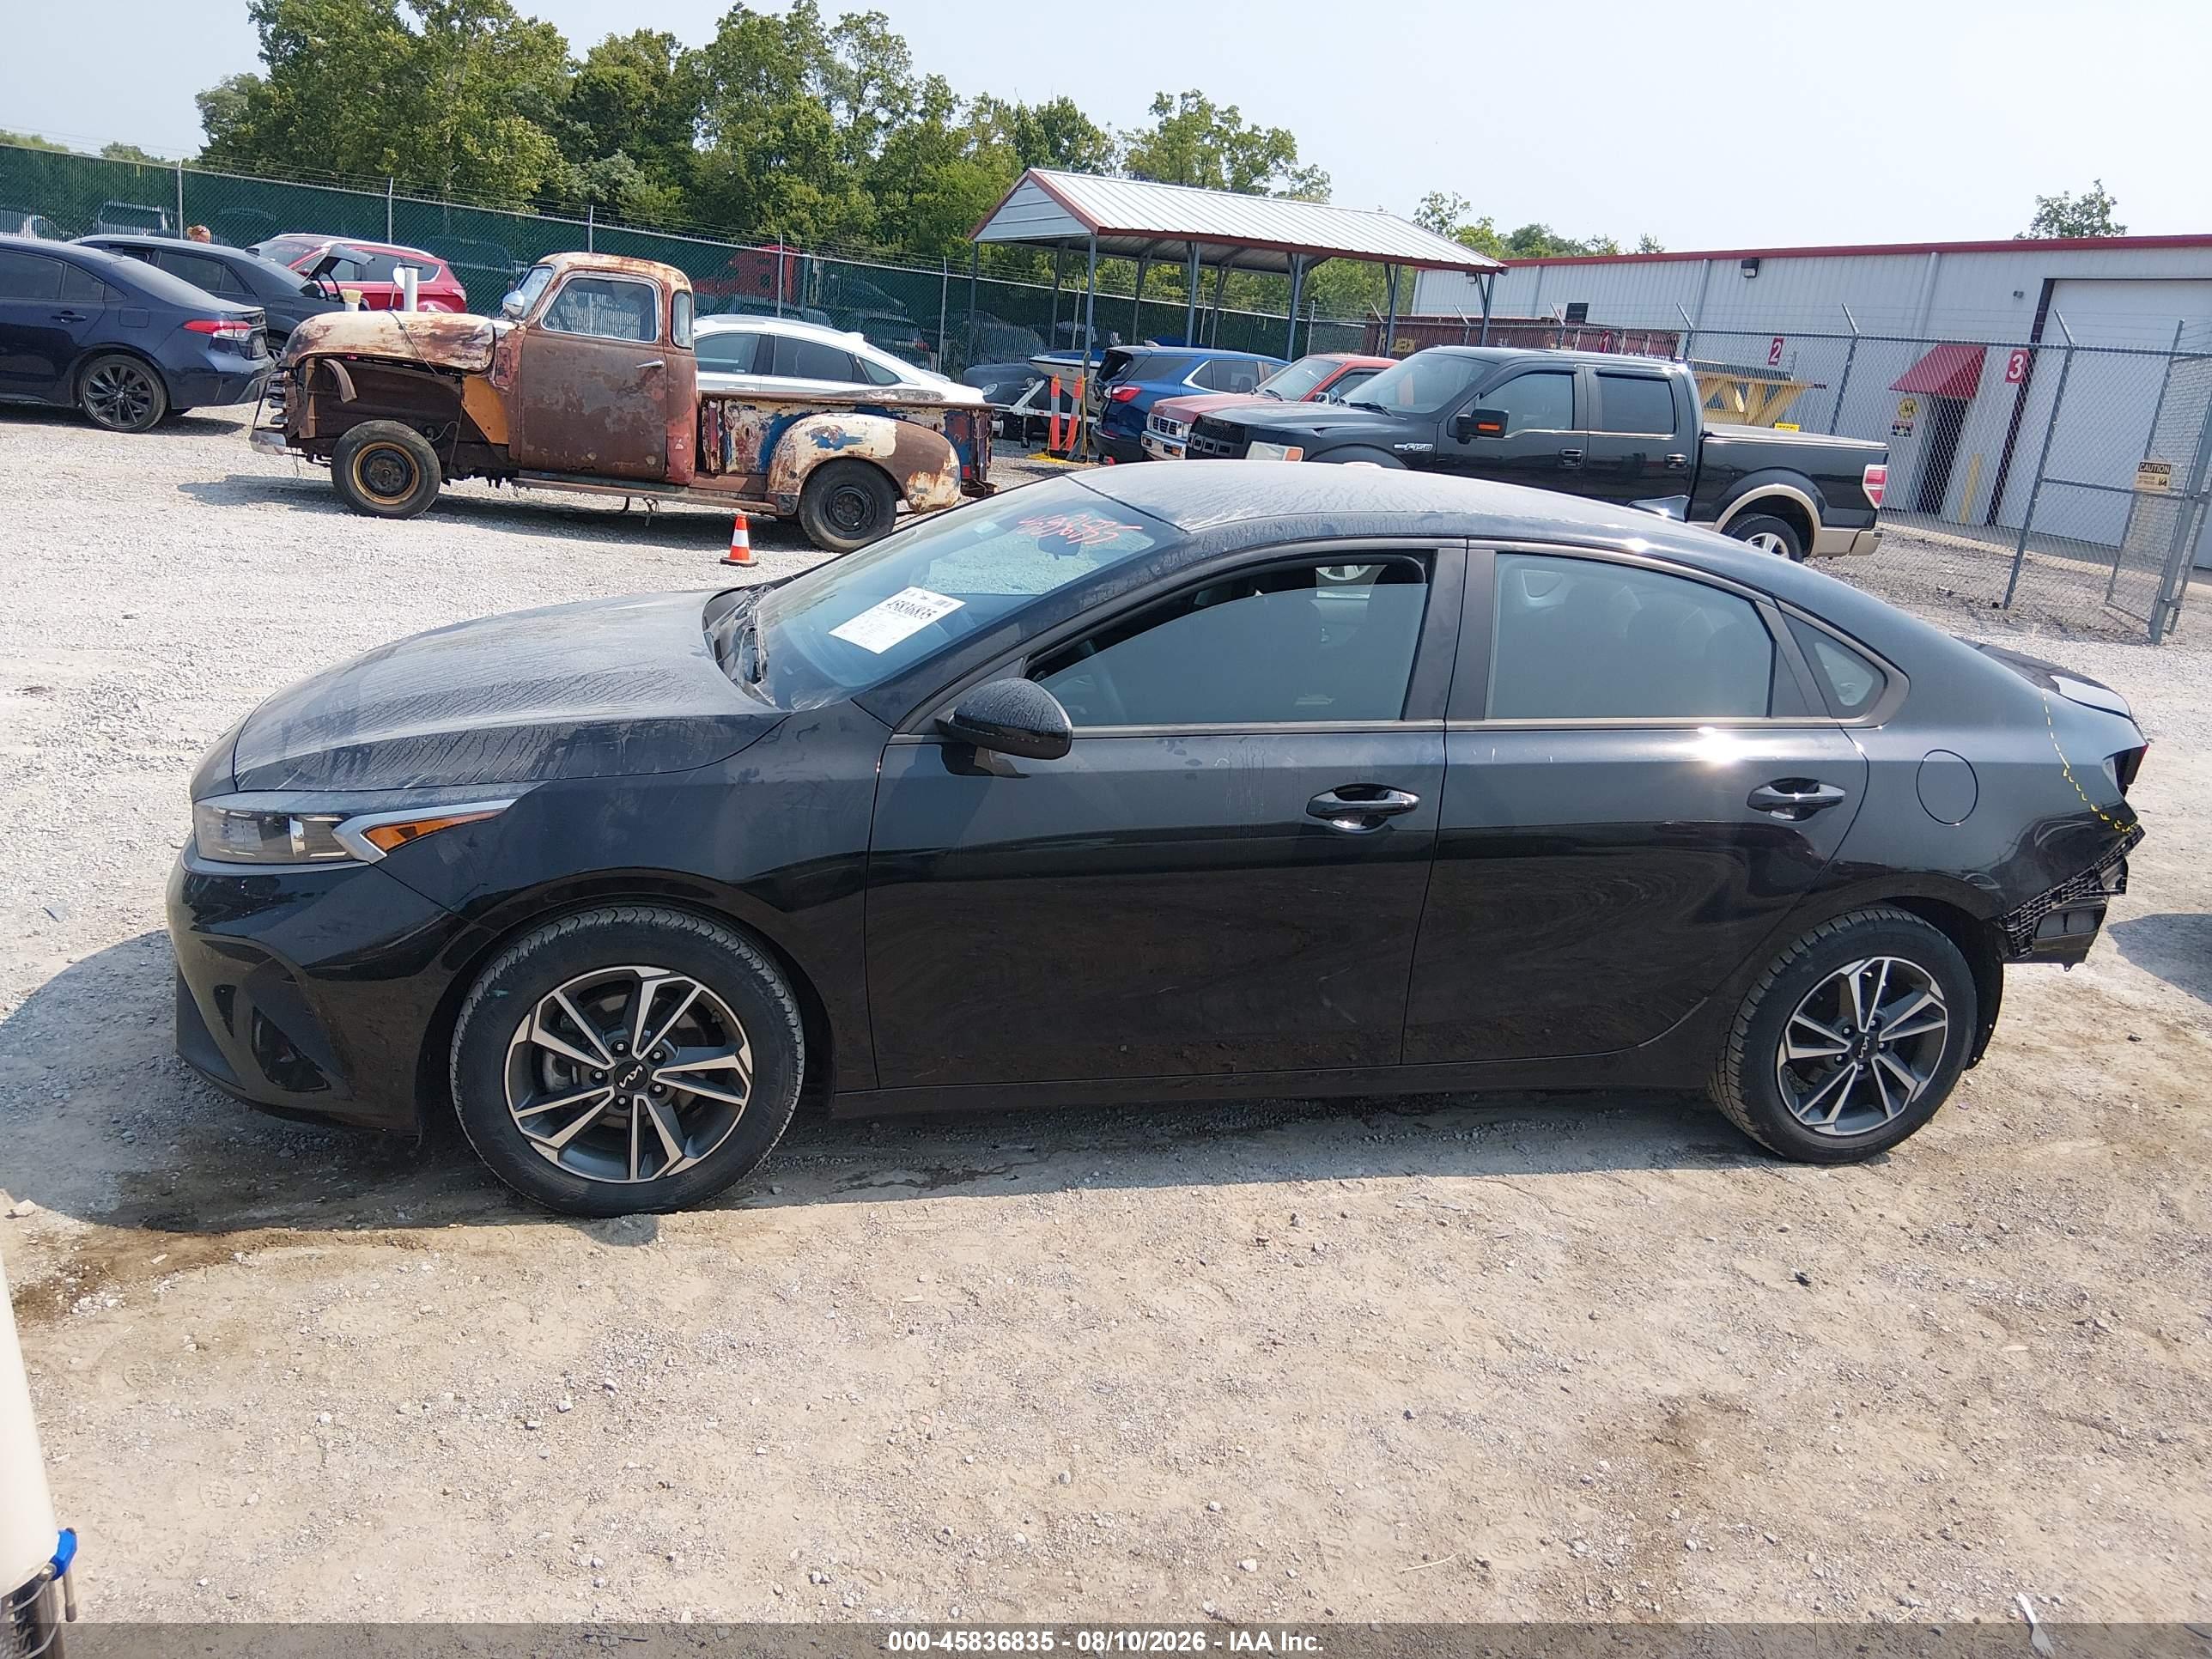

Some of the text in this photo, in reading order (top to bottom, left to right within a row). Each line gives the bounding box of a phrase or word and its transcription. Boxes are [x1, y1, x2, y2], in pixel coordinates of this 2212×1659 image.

[1769, 341, 1782, 363] 2
[2008, 354, 2024, 380] 3
[2138, 463, 2171, 474] CAUTION
